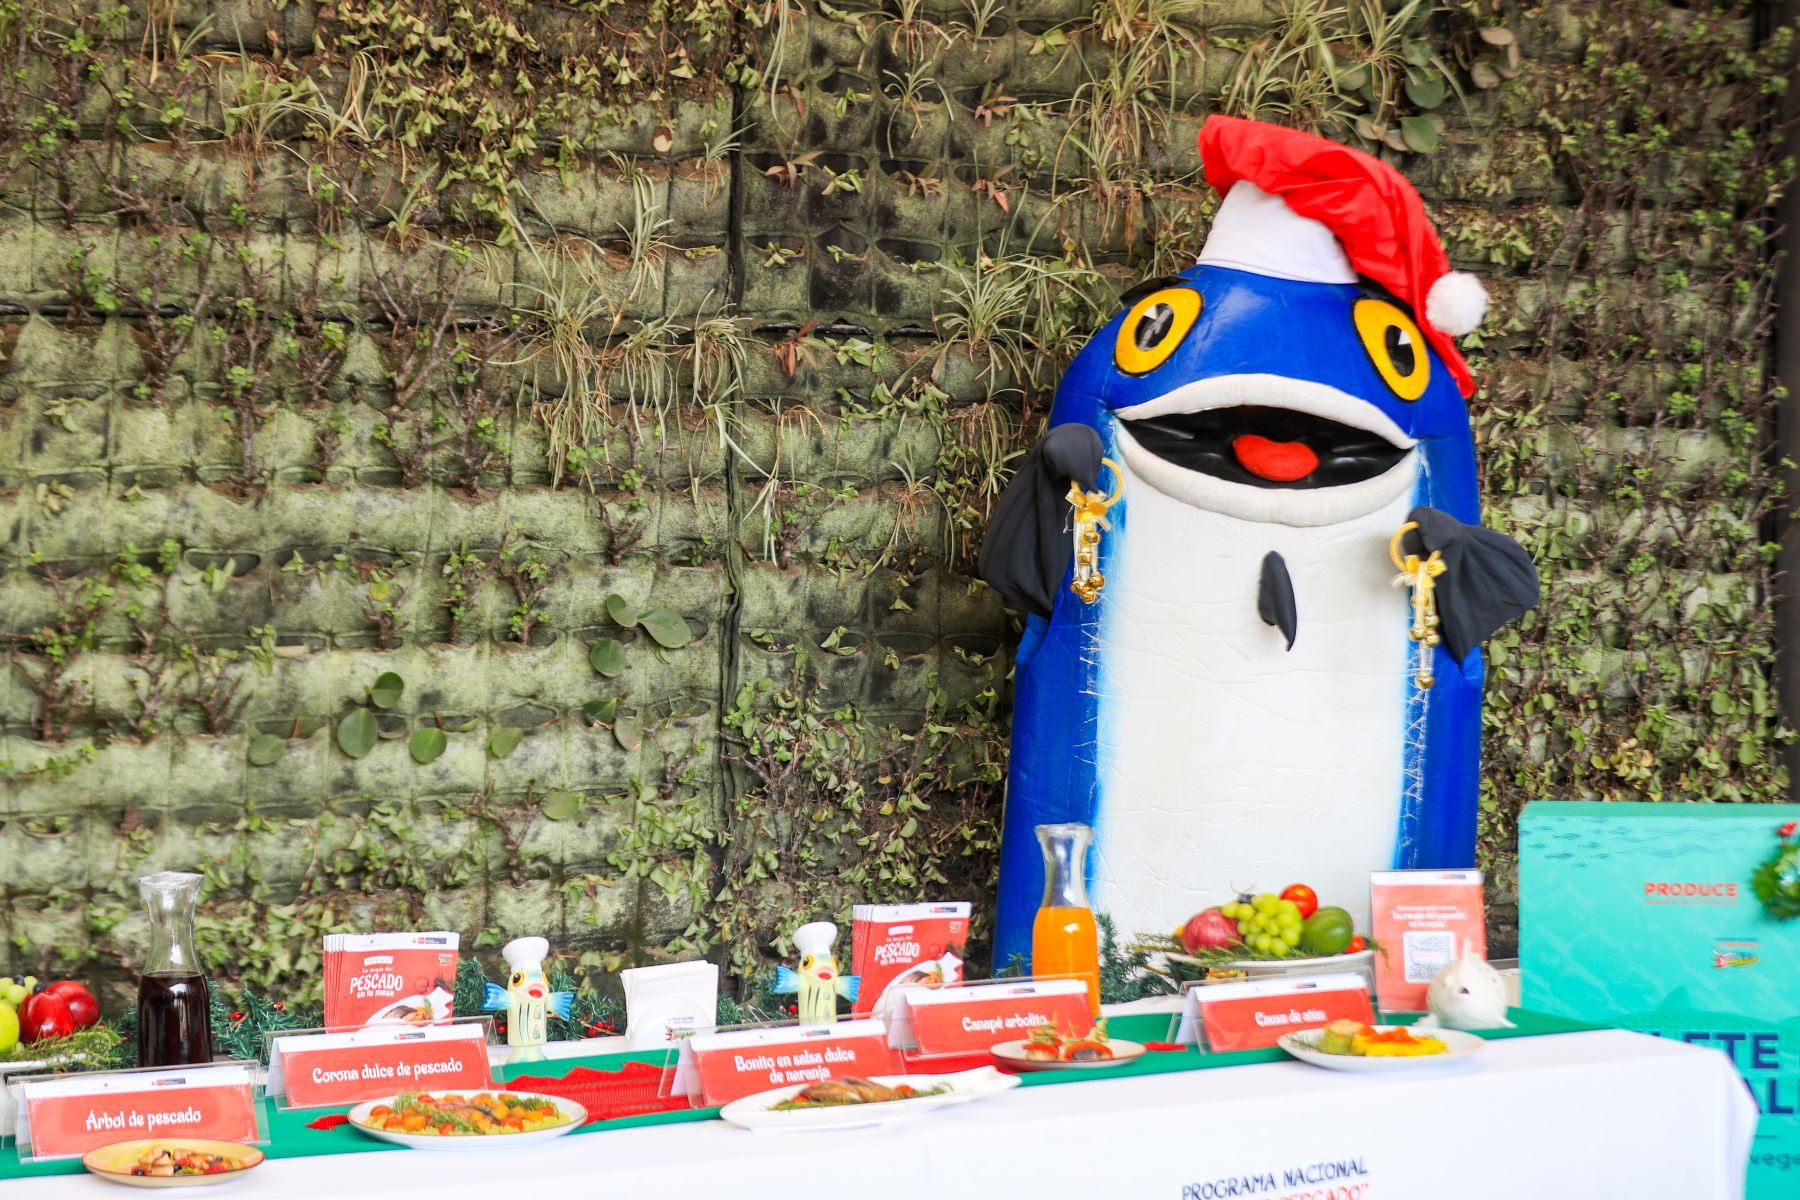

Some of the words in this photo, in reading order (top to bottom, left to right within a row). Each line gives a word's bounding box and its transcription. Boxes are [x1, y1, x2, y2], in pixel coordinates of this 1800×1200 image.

[1644, 882, 1737, 897] PRODUCE
[874, 942, 920, 962] PESCADO
[349, 973, 403, 993] PESCADO
[962, 1016, 1002, 1034] Canapé
[1005, 1013, 1047, 1028] arbolito
[1255, 1011, 1287, 1027] Causa
[1289, 1009, 1301, 1022] de
[1302, 1007, 1326, 1022] atún
[734, 1055, 775, 1072] Bonito
[777, 1056, 791, 1067] en
[793, 1050, 822, 1066] salsa
[824, 1046, 855, 1063] dulce
[312, 1067, 359, 1083] Corona
[362, 1063, 394, 1079] dulce
[396, 1061, 411, 1076] de
[414, 1057, 463, 1080] pescado
[770, 1070, 783, 1084] de
[785, 1065, 831, 1083] naranja
[86, 1109, 125, 1130] Árbol
[129, 1110, 144, 1126] de
[147, 1106, 201, 1131] pescado
[1181, 1172, 1276, 1200] PROGRAMA
[1283, 1157, 1368, 1187] NACIONAL
